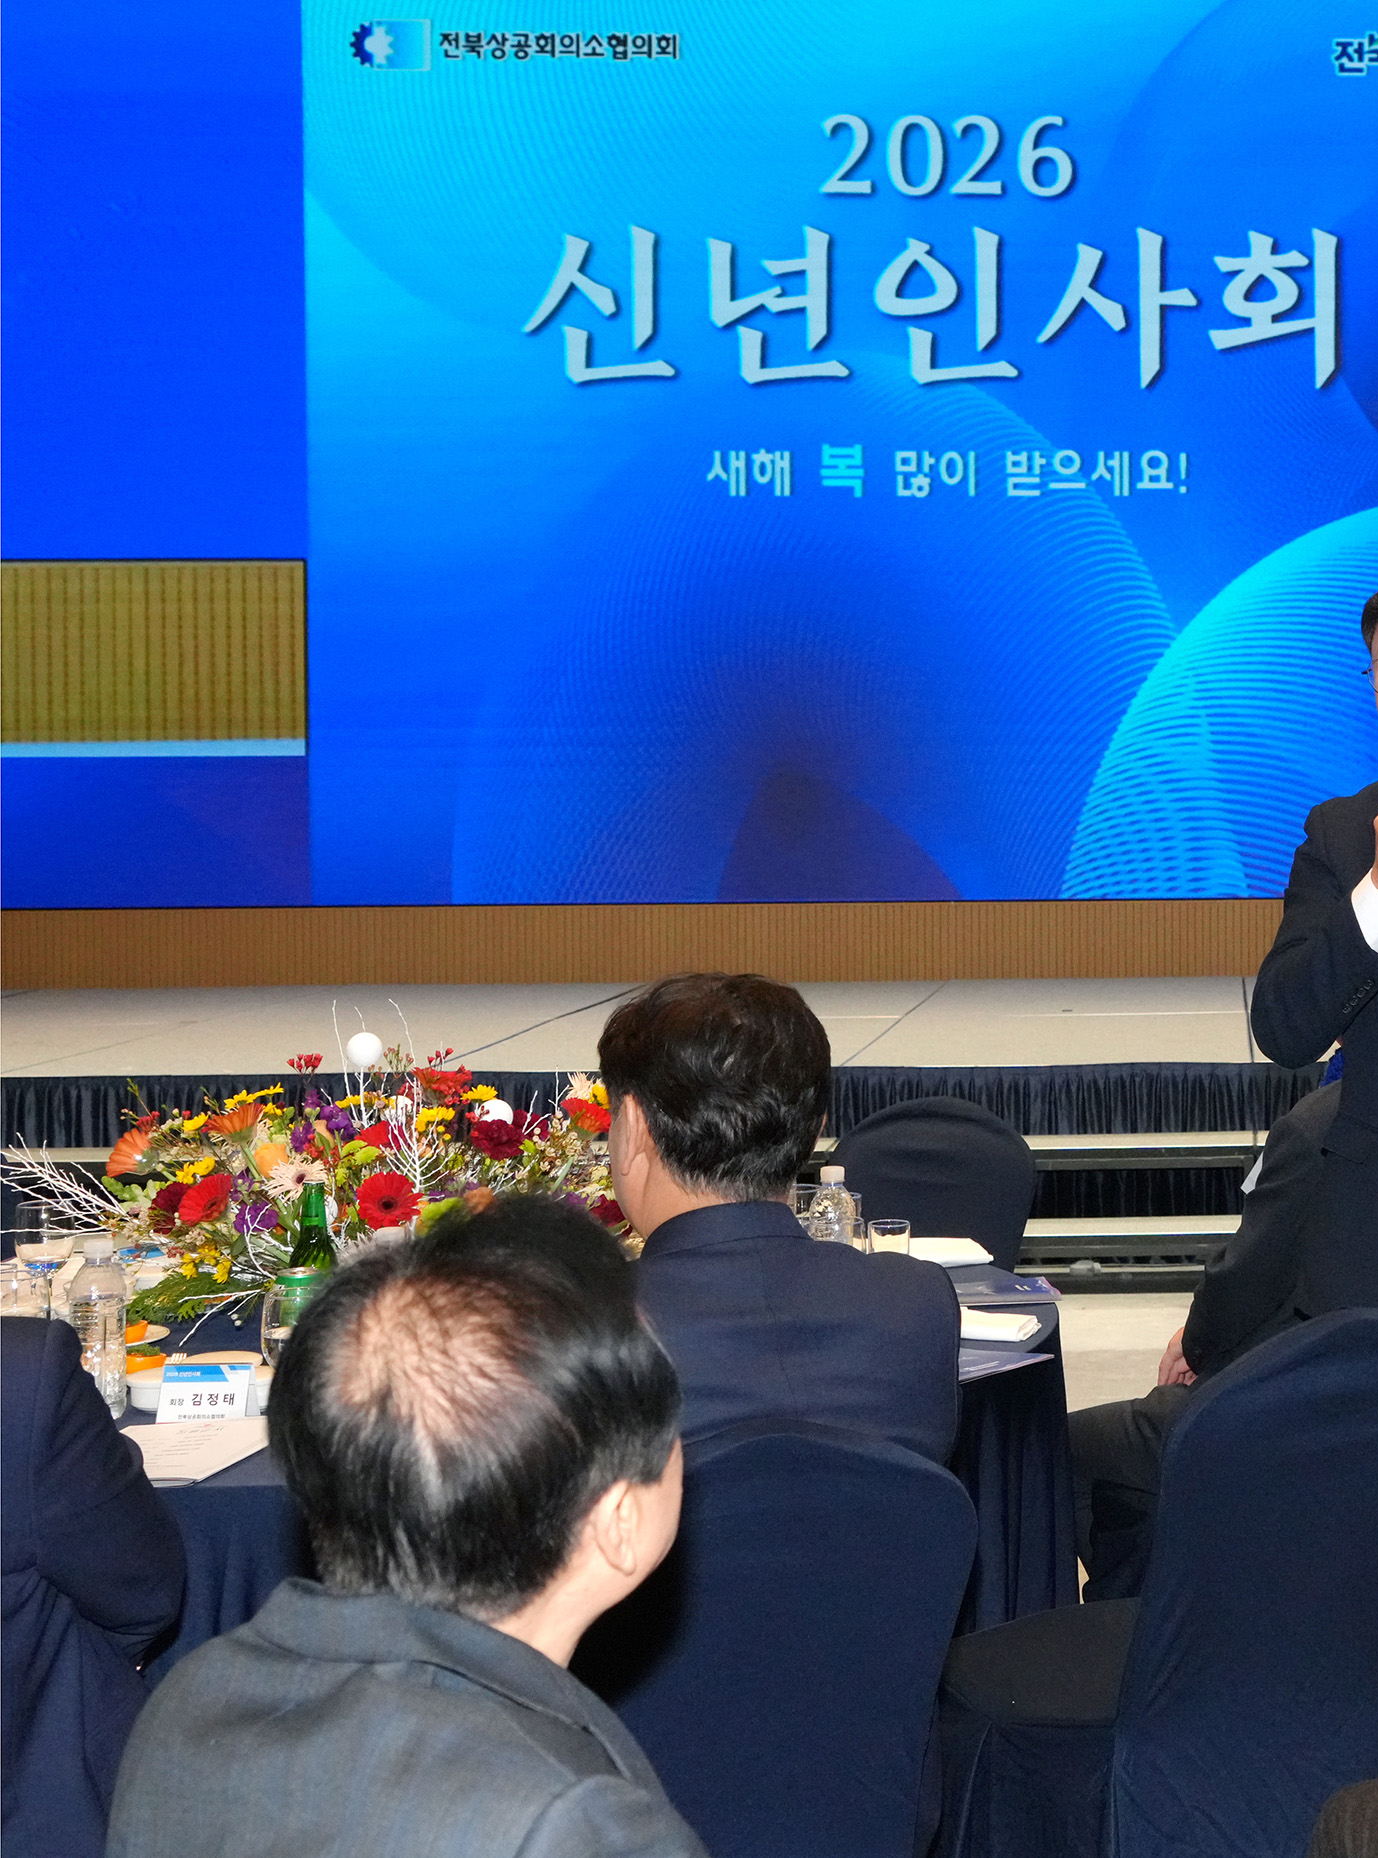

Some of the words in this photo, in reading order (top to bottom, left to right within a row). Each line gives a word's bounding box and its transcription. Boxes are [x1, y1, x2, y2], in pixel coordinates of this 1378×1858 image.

[439, 32, 679, 61] 전북상공회의소협의회
[821, 114, 1076, 198] 2026
[523, 225, 1340, 390] 신년인사회
[706, 448, 794, 497] 새해
[820, 443, 865, 498] 복
[894, 449, 978, 498] 많이
[1004, 448, 1190, 497] 받으세요!
[169, 1398, 184, 1406] 회장
